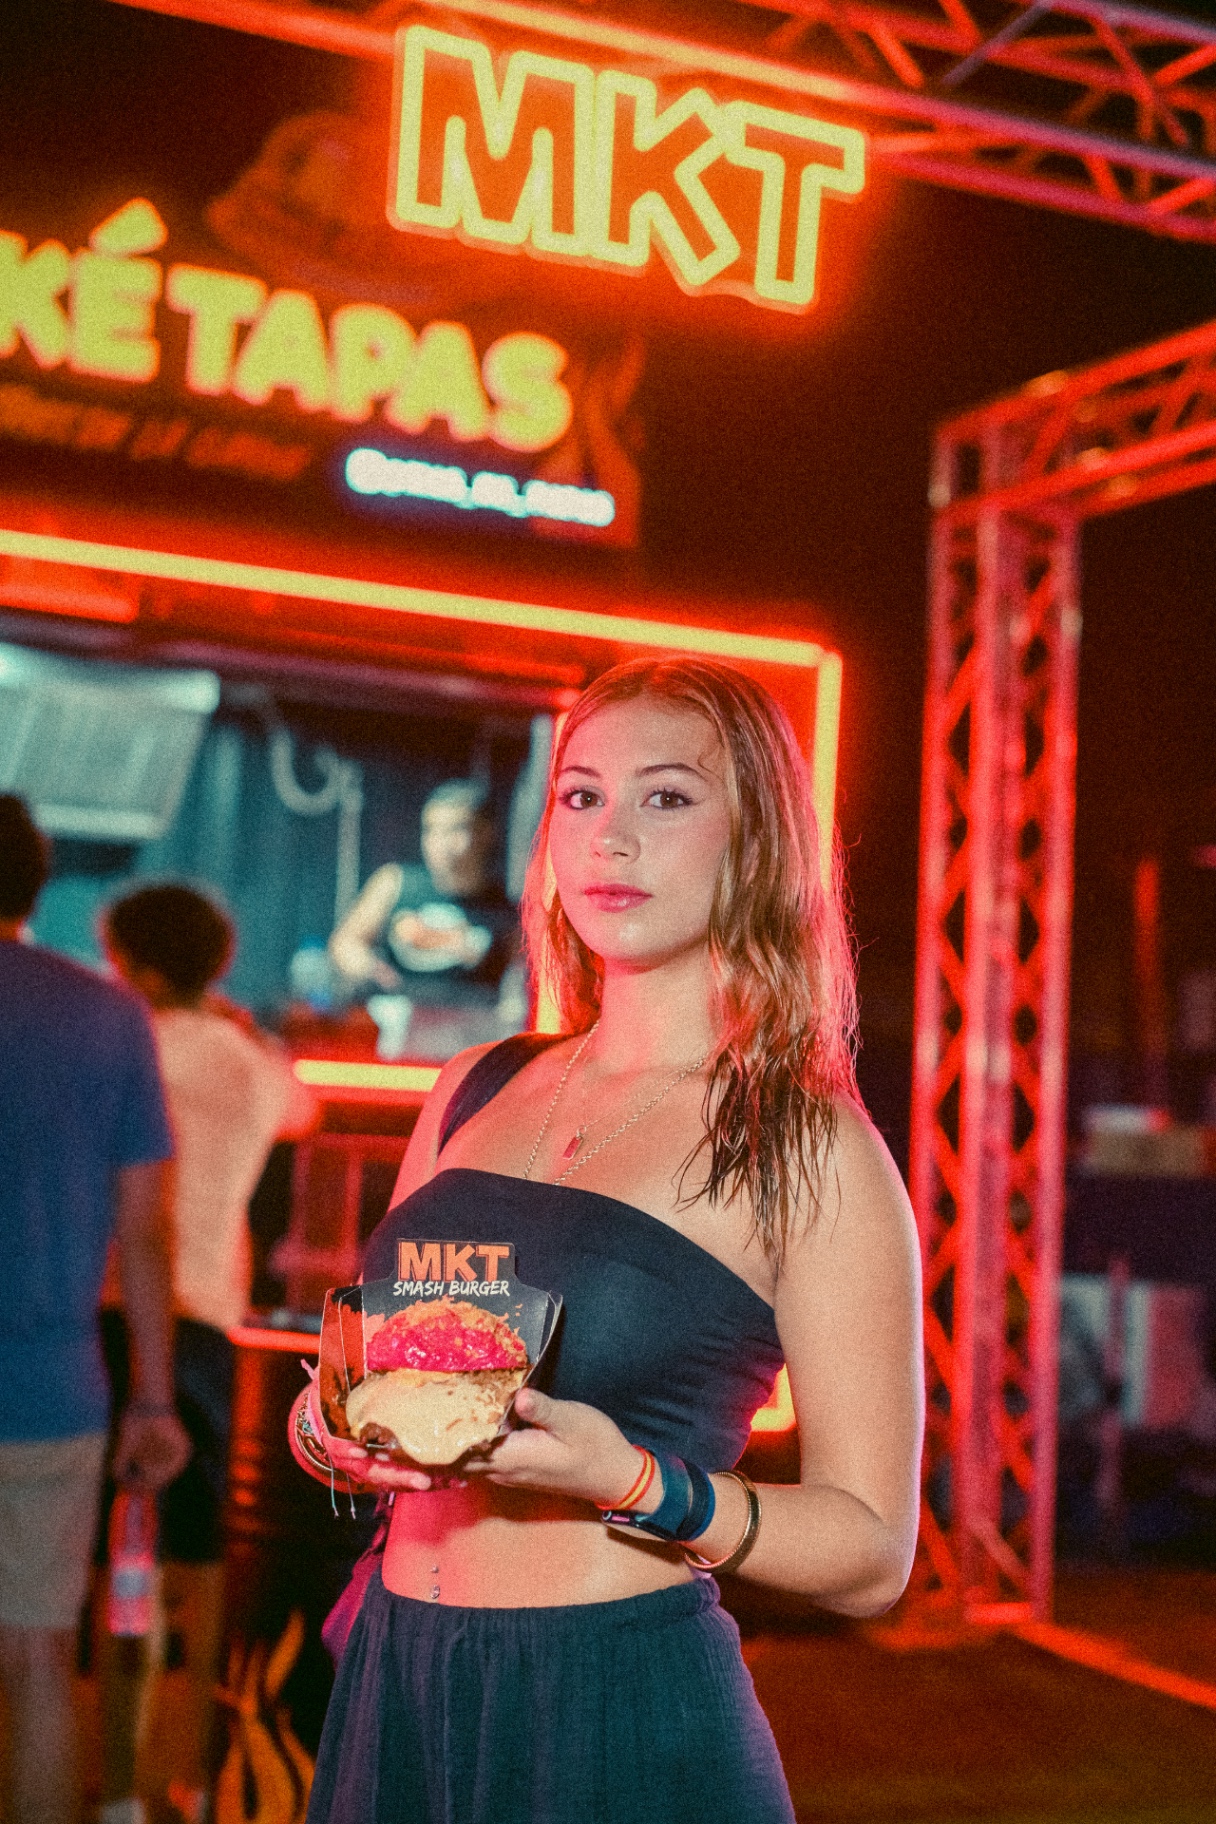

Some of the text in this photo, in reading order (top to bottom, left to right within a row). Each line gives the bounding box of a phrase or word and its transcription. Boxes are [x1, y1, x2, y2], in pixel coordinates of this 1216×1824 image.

[391, 26, 867, 311] MKT
[166, 264, 573, 452] TAPAS
[393, 1281, 510, 1297] SMASH BURGER
[399, 1242, 510, 1282] MKT
